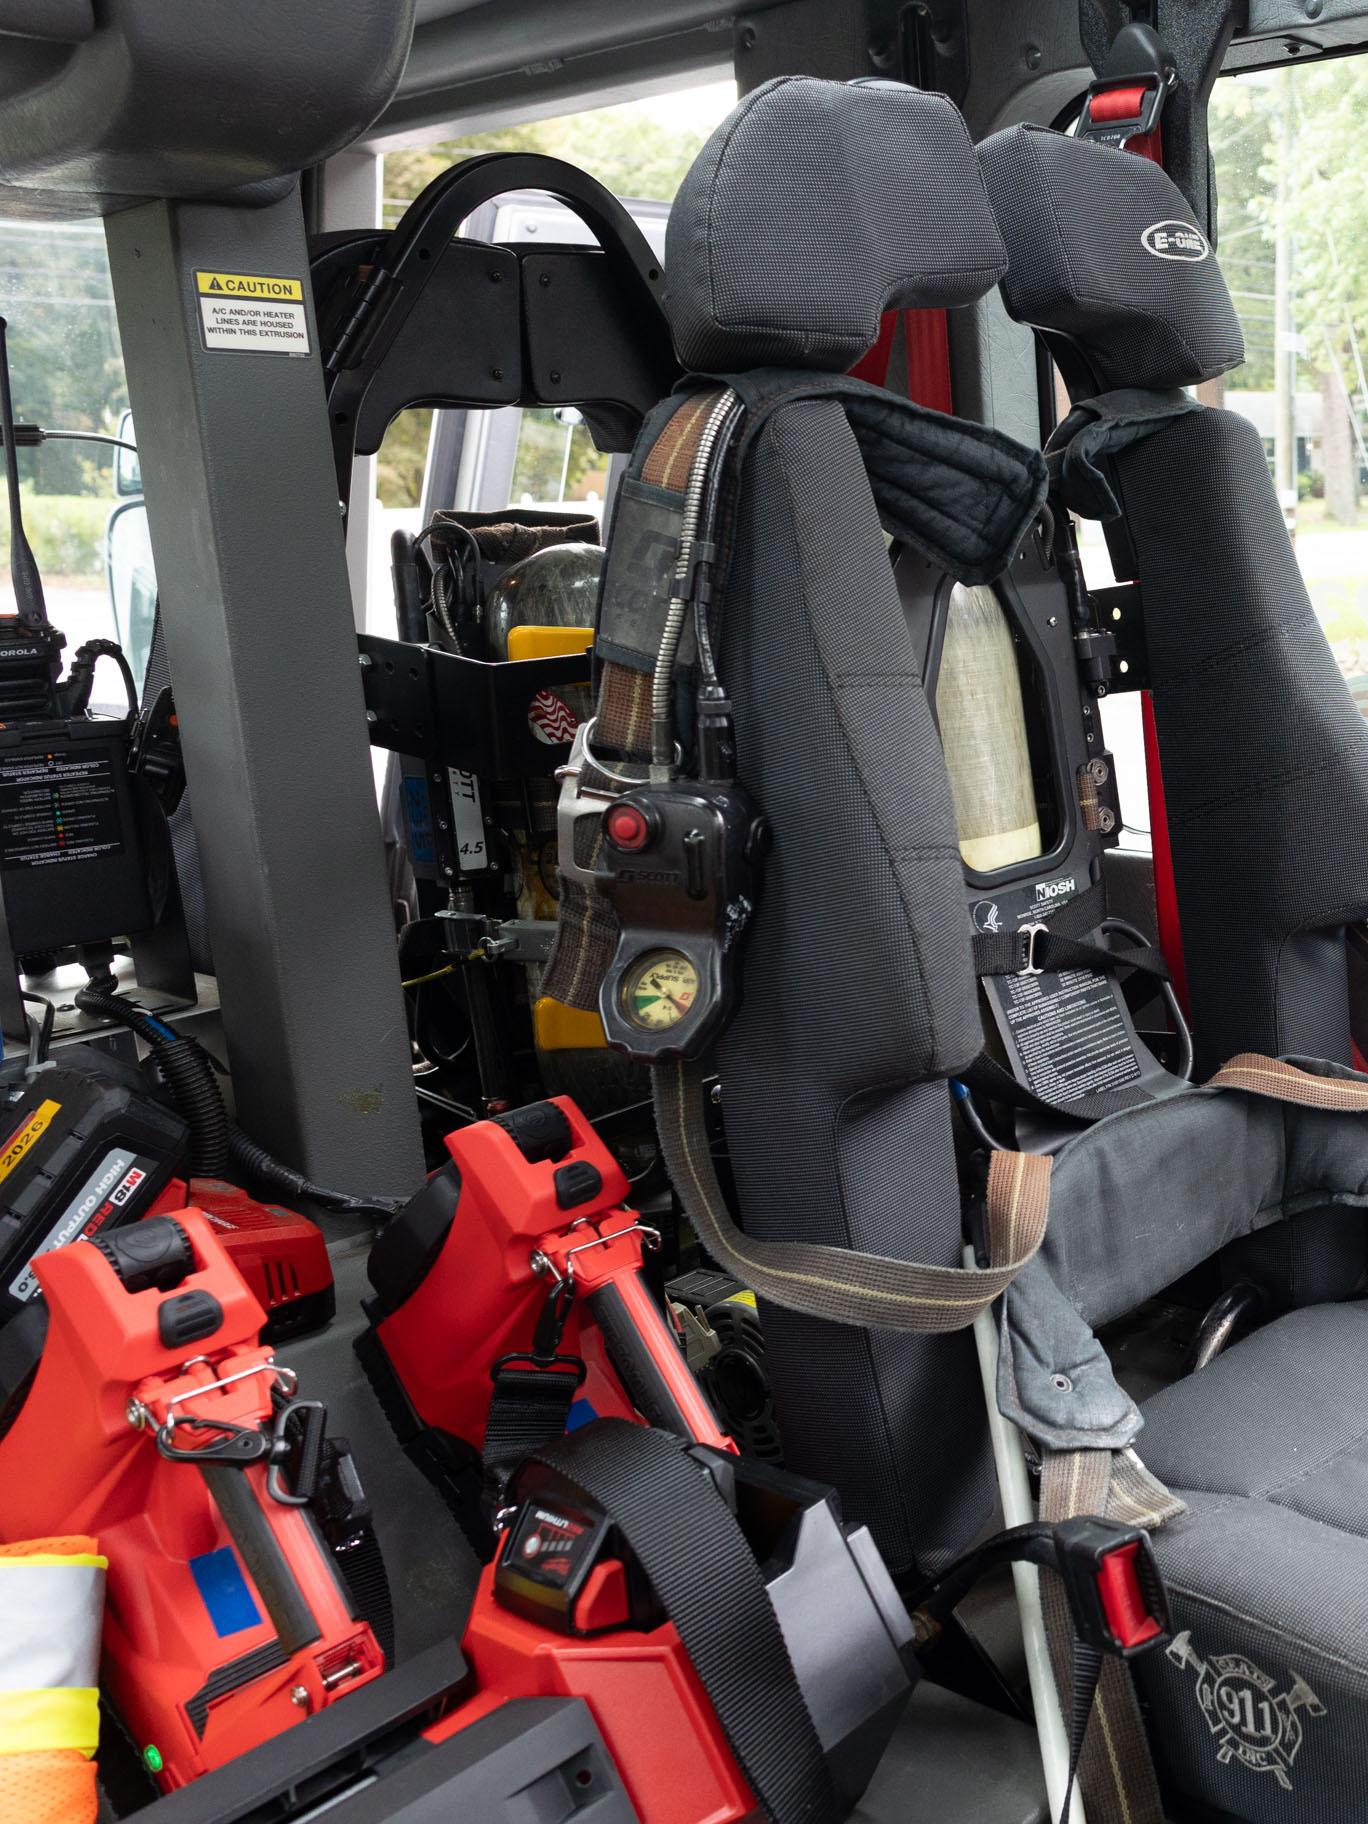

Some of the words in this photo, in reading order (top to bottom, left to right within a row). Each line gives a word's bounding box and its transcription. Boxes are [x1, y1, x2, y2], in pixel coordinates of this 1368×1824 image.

[225, 279, 293, 296] CAUTION
[211, 307, 227, 315] A/C
[229, 309, 261, 317] AND/OR
[263, 311, 295, 319] HEATER
[215, 318, 240, 326] LINES
[260, 321, 294, 329] HOUSED
[207, 327, 237, 335] WITHIN
[259, 330, 304, 339] EXTRUSION
[0, 648, 37, 657] OROLA
[460, 841, 484, 856] 4.5
[1035, 879, 1075, 901] NIOSH
[2, 1121, 44, 1168] 2026
[96, 1159, 125, 1194] HIGH
[114, 1169, 143, 1205] M18
[53, 1194, 97, 1249] OUTPUT
[1220, 1686, 1276, 1742] 911
[1238, 1744, 1268, 1765] INC
